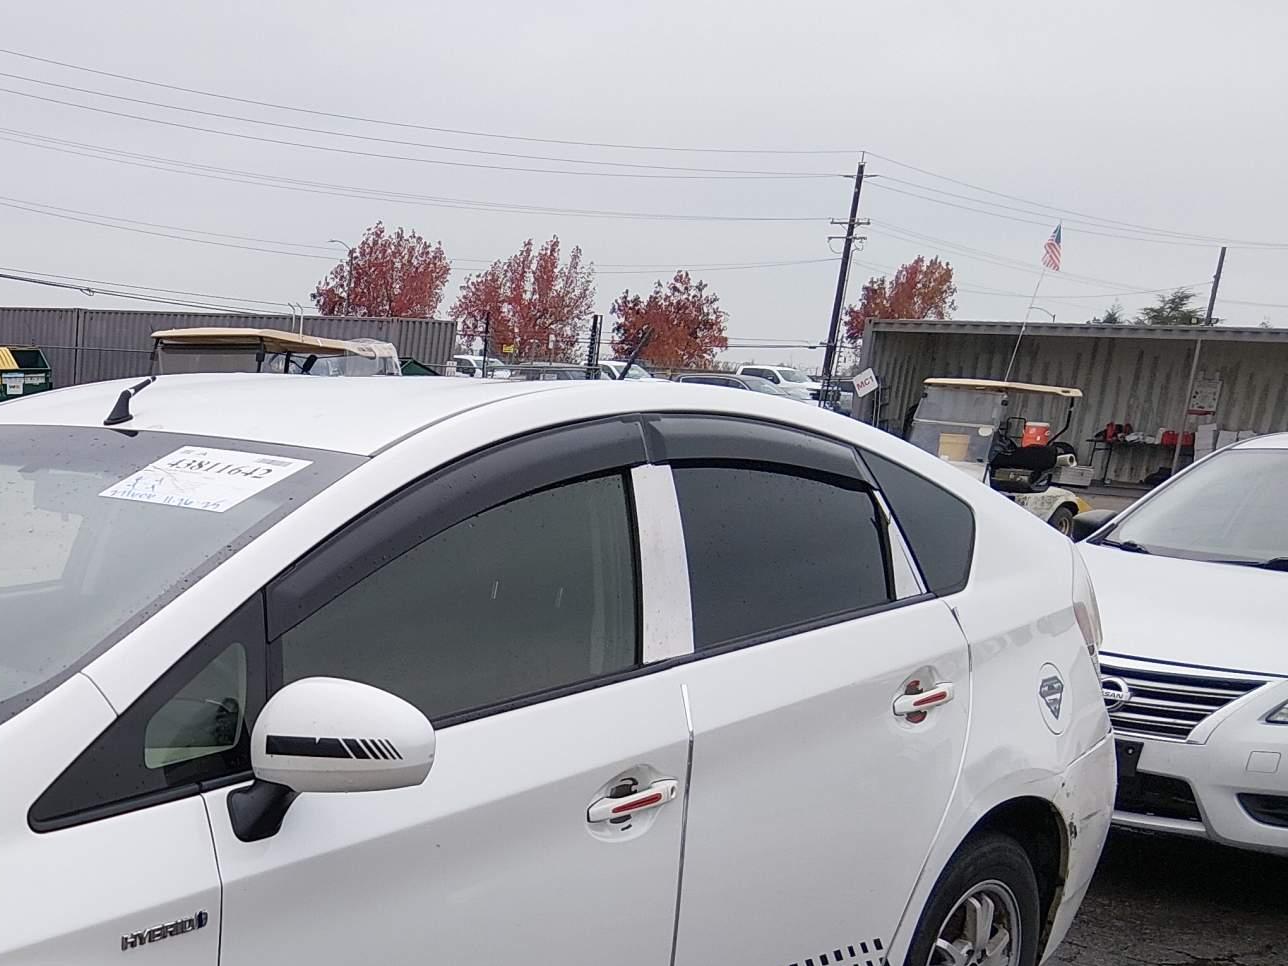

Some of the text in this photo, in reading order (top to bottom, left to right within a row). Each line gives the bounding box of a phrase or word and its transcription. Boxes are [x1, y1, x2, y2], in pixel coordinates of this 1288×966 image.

[856, 375, 874, 390] MC1
[167, 458, 273, 479] 43811642
[121, 917, 195, 952] HYBRID
